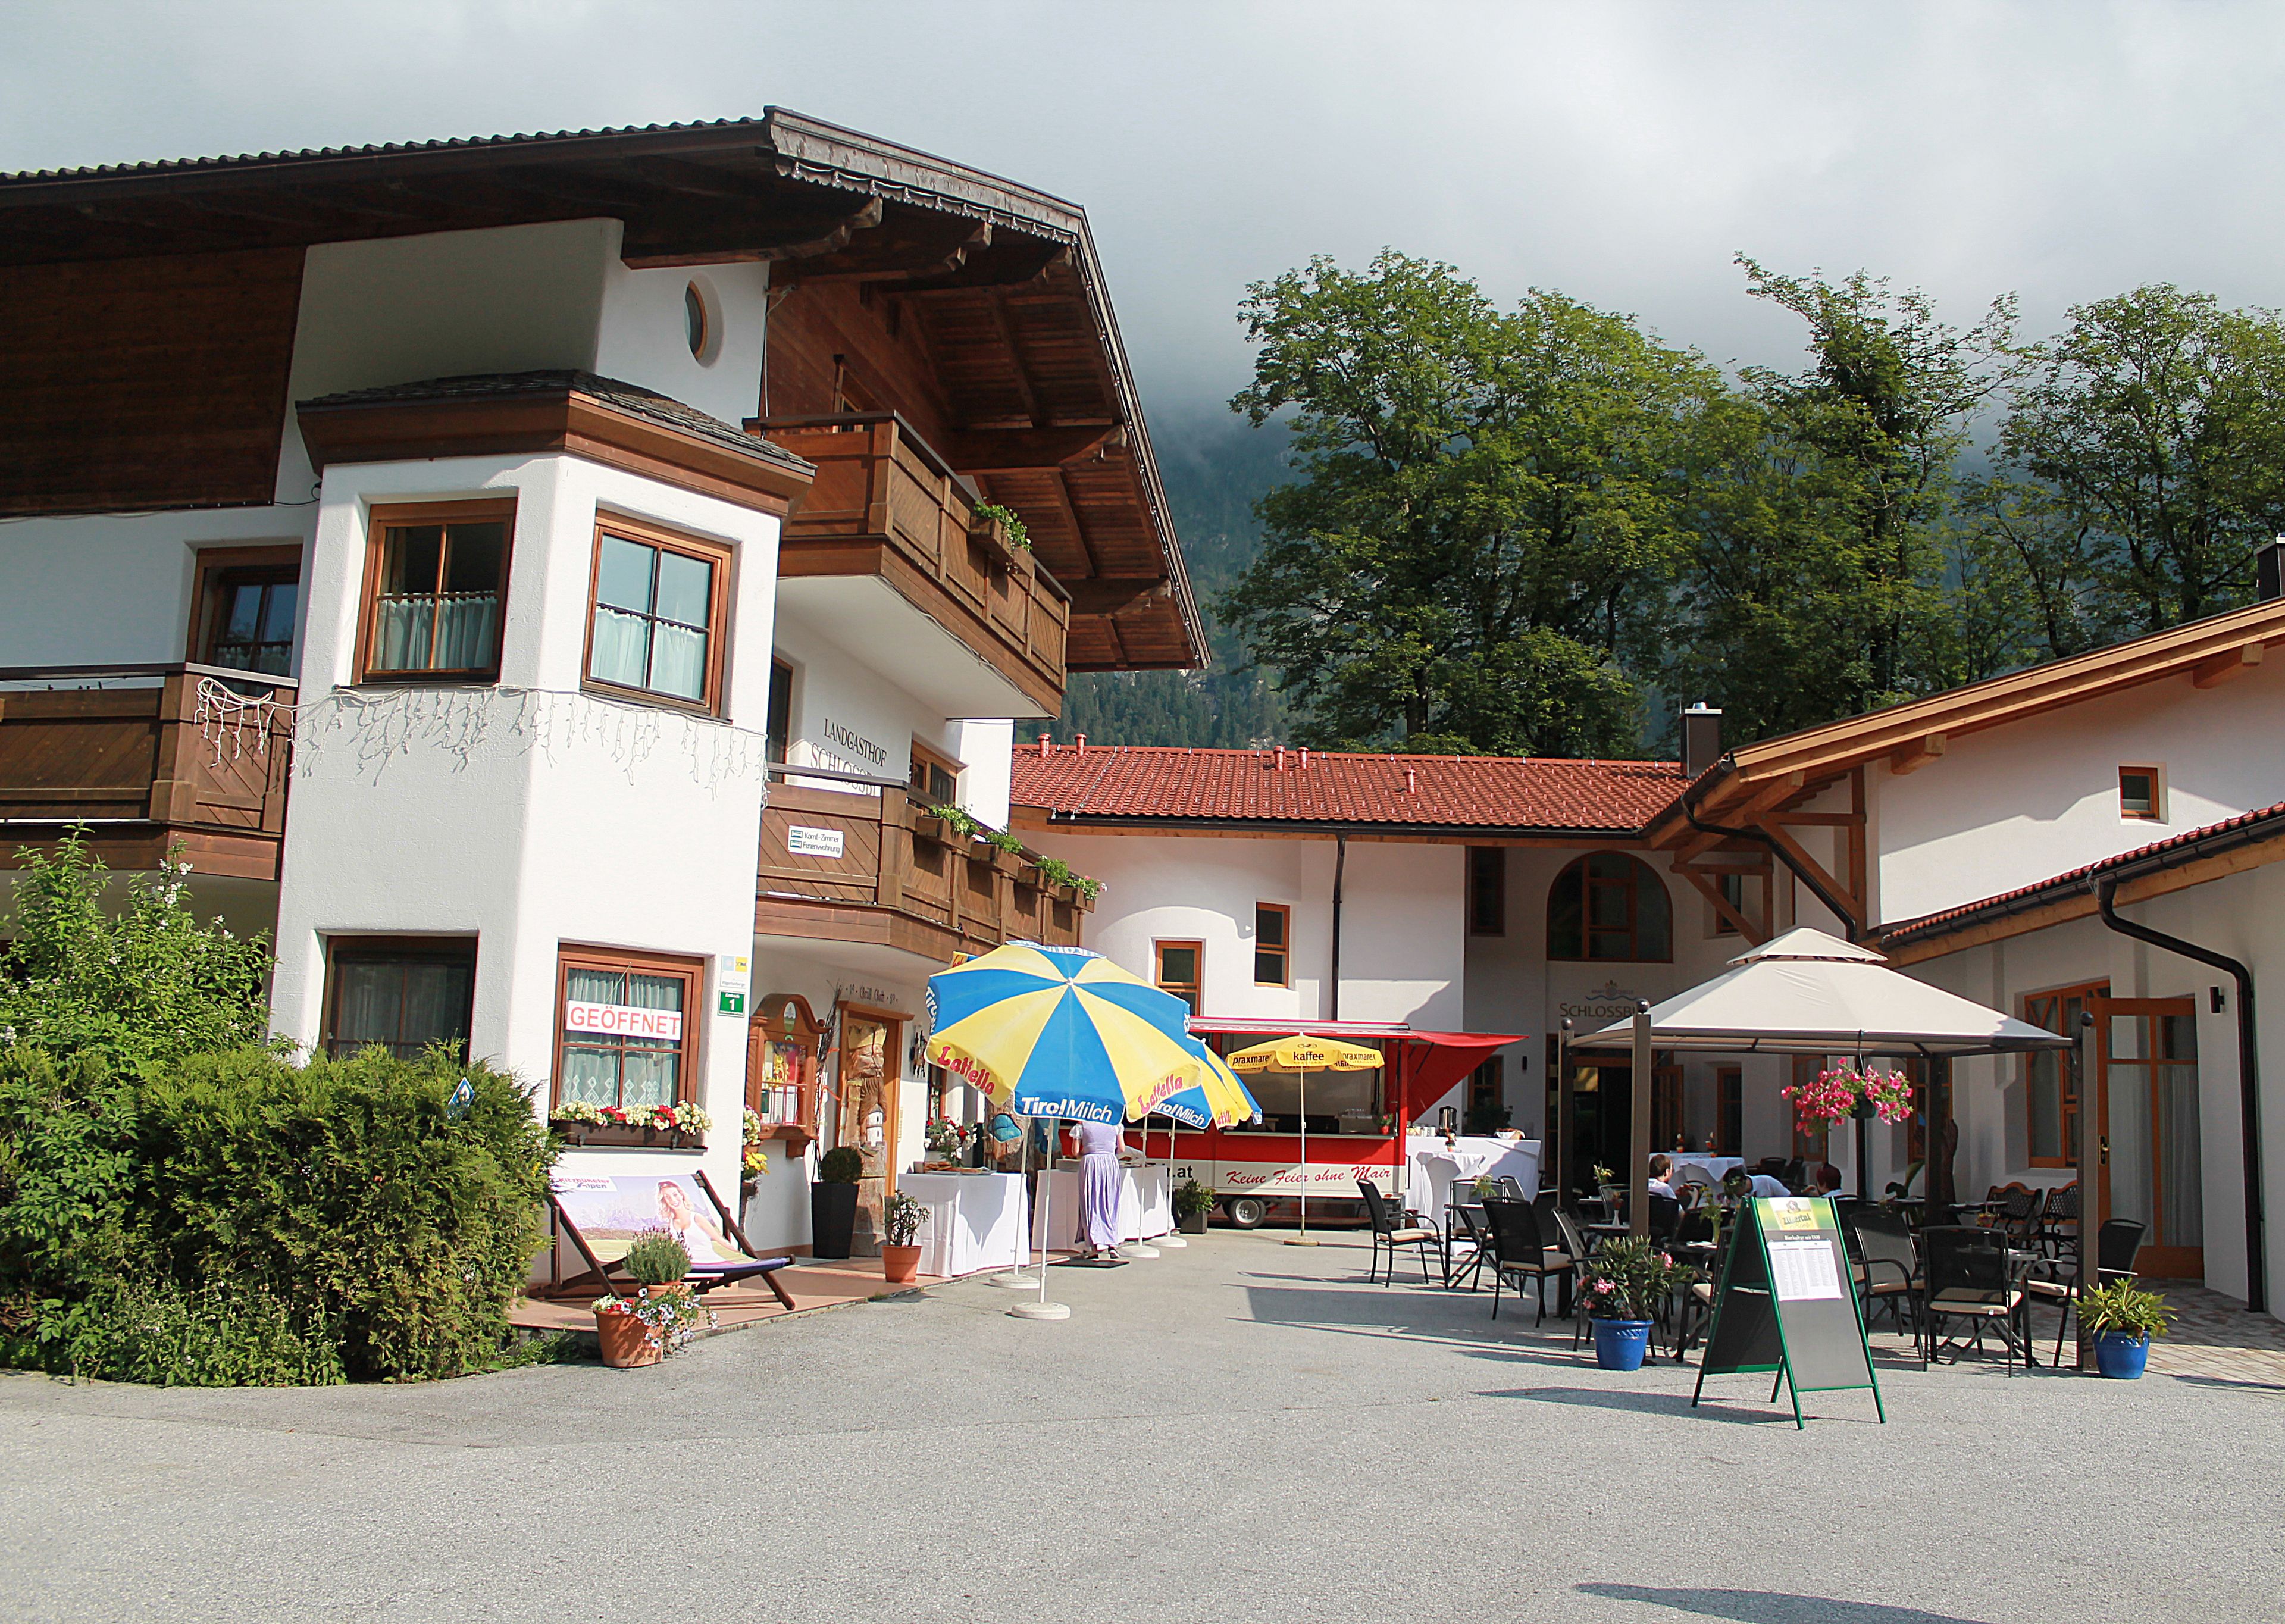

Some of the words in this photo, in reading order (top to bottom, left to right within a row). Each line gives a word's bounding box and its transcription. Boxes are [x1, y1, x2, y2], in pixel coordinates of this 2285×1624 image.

[824, 718, 887, 767] LANDGASTHOF
[803, 842, 840, 854] Ferienwohnung
[729, 999, 735, 1010] 1
[570, 1006, 681, 1035] GEÖFFNET
[1293, 1051, 1325, 1061] kaffee
[937, 1046, 996, 1096] Lattella
[1137, 1073, 1183, 1115] Lattella
[1021, 1097, 1113, 1122] TirolMilch
[1226, 1171, 1267, 1184] Keine
[1273, 1169, 1309, 1185] Feier
[1314, 1168, 1345, 1182] ohne
[1351, 1166, 1391, 1179] Mair
